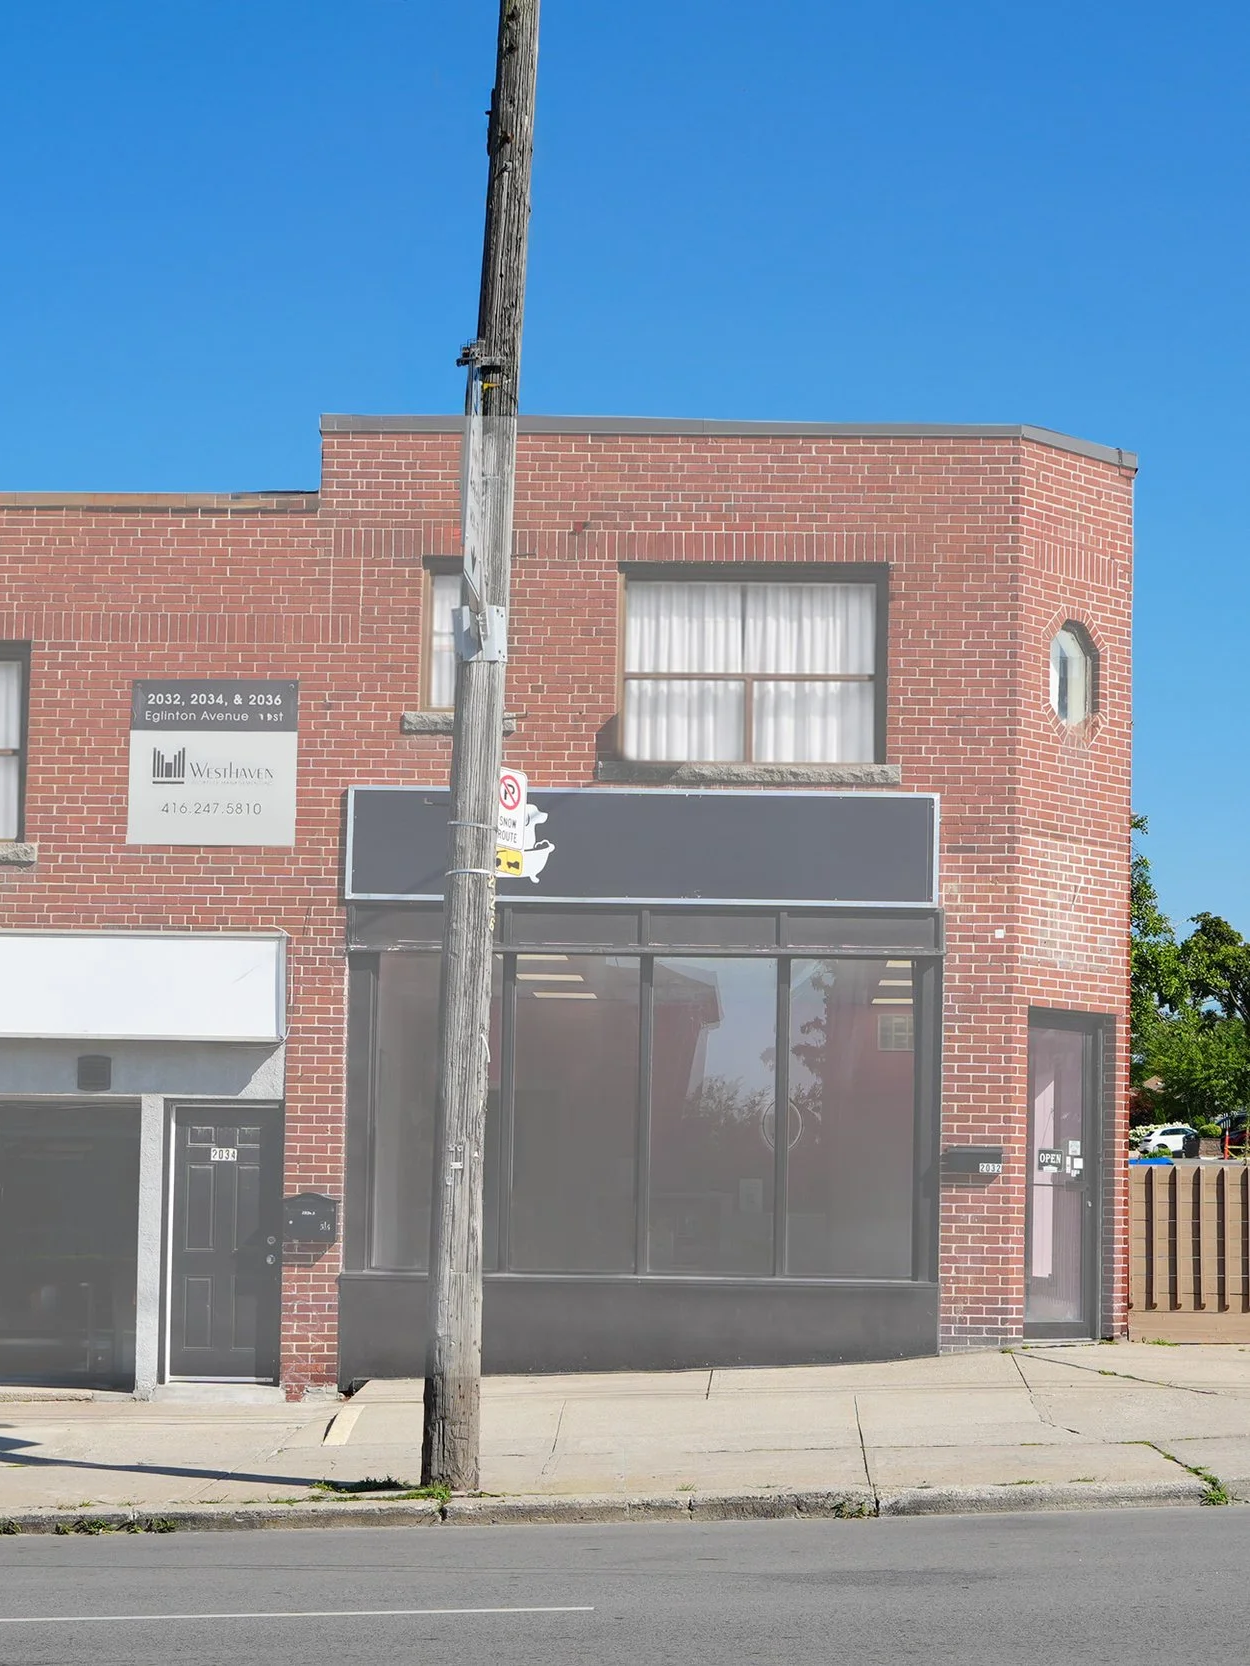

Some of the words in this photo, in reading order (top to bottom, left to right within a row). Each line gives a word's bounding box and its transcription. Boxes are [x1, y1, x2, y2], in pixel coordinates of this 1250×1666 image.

[147, 693, 186, 706] 2032,
[190, 693, 228, 707] 2034,
[233, 693, 243, 705] &
[248, 694, 282, 706] 2036
[145, 711, 196, 723] Eglinton
[200, 711, 249, 721] Avenue
[161, 802, 262, 815] 416.247.5810
[499, 815, 518, 829] SNOW
[496, 829, 518, 844] ROUTE
[212, 1149, 236, 1160] 2034
[1039, 1153, 1062, 1164] OPEN
[980, 1163, 1001, 1173] 2032
